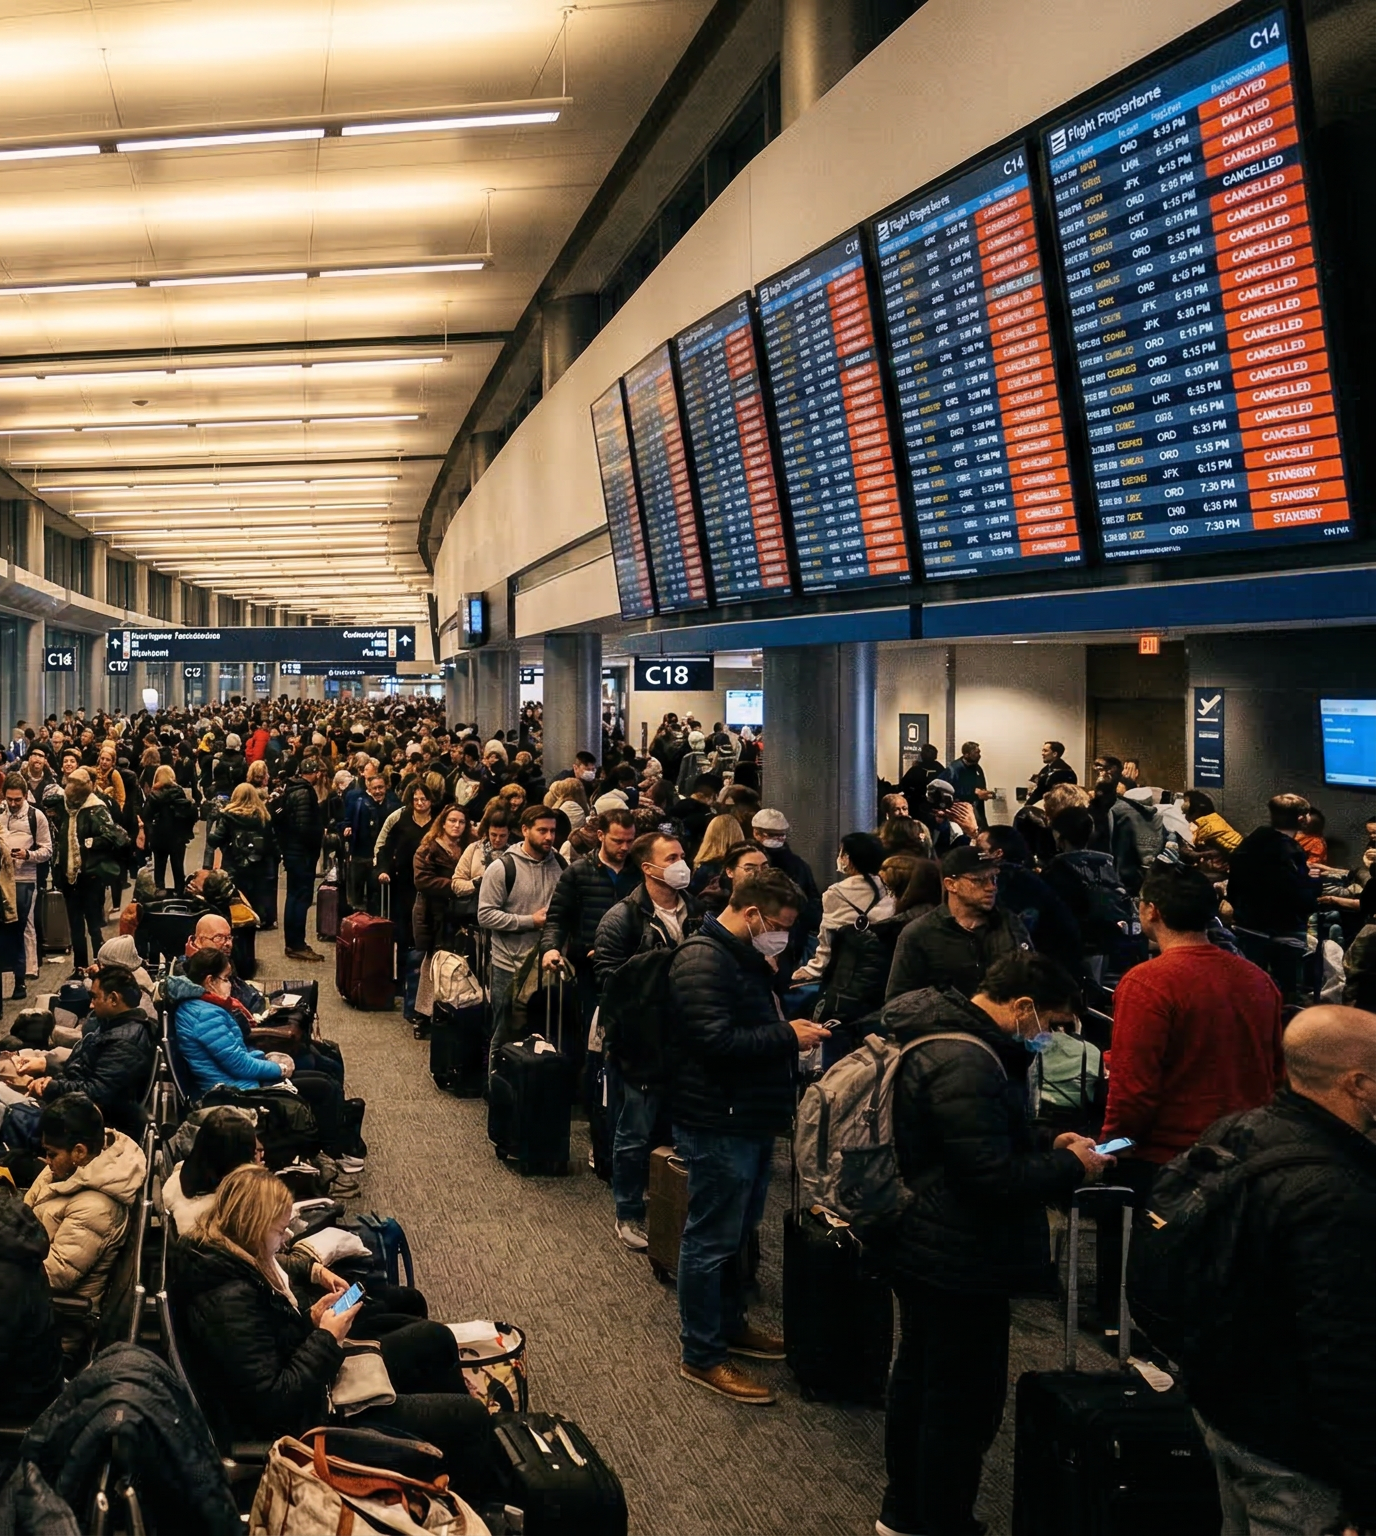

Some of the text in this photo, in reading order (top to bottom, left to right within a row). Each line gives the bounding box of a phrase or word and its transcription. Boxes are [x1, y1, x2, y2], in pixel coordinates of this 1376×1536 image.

[1249, 22, 1279, 48] C14
[1003, 154, 1024, 174] C14
[1224, 173, 1284, 203] CANCELLED
[1226, 193, 1287, 222] CANCELLED
[1229, 214, 1290, 242] CANCELLED
[1231, 234, 1292, 262] CANCELLED
[1234, 255, 1295, 281] CANCELLED
[1237, 276, 1297, 301] CANCELLED
[1240, 297, 1300, 321] CANCELLED
[1147, 354, 1167, 367] ORD
[1243, 318, 1302, 341] CANCELLED
[1246, 339, 1305, 361] CANCELLED
[1249, 360, 1307, 381] CANCELLED
[1252, 381, 1310, 401] CANCELLED
[1156, 429, 1176, 441] ORD
[1255, 402, 1312, 421] CANCELLED
[645, 665, 689, 685] C18
